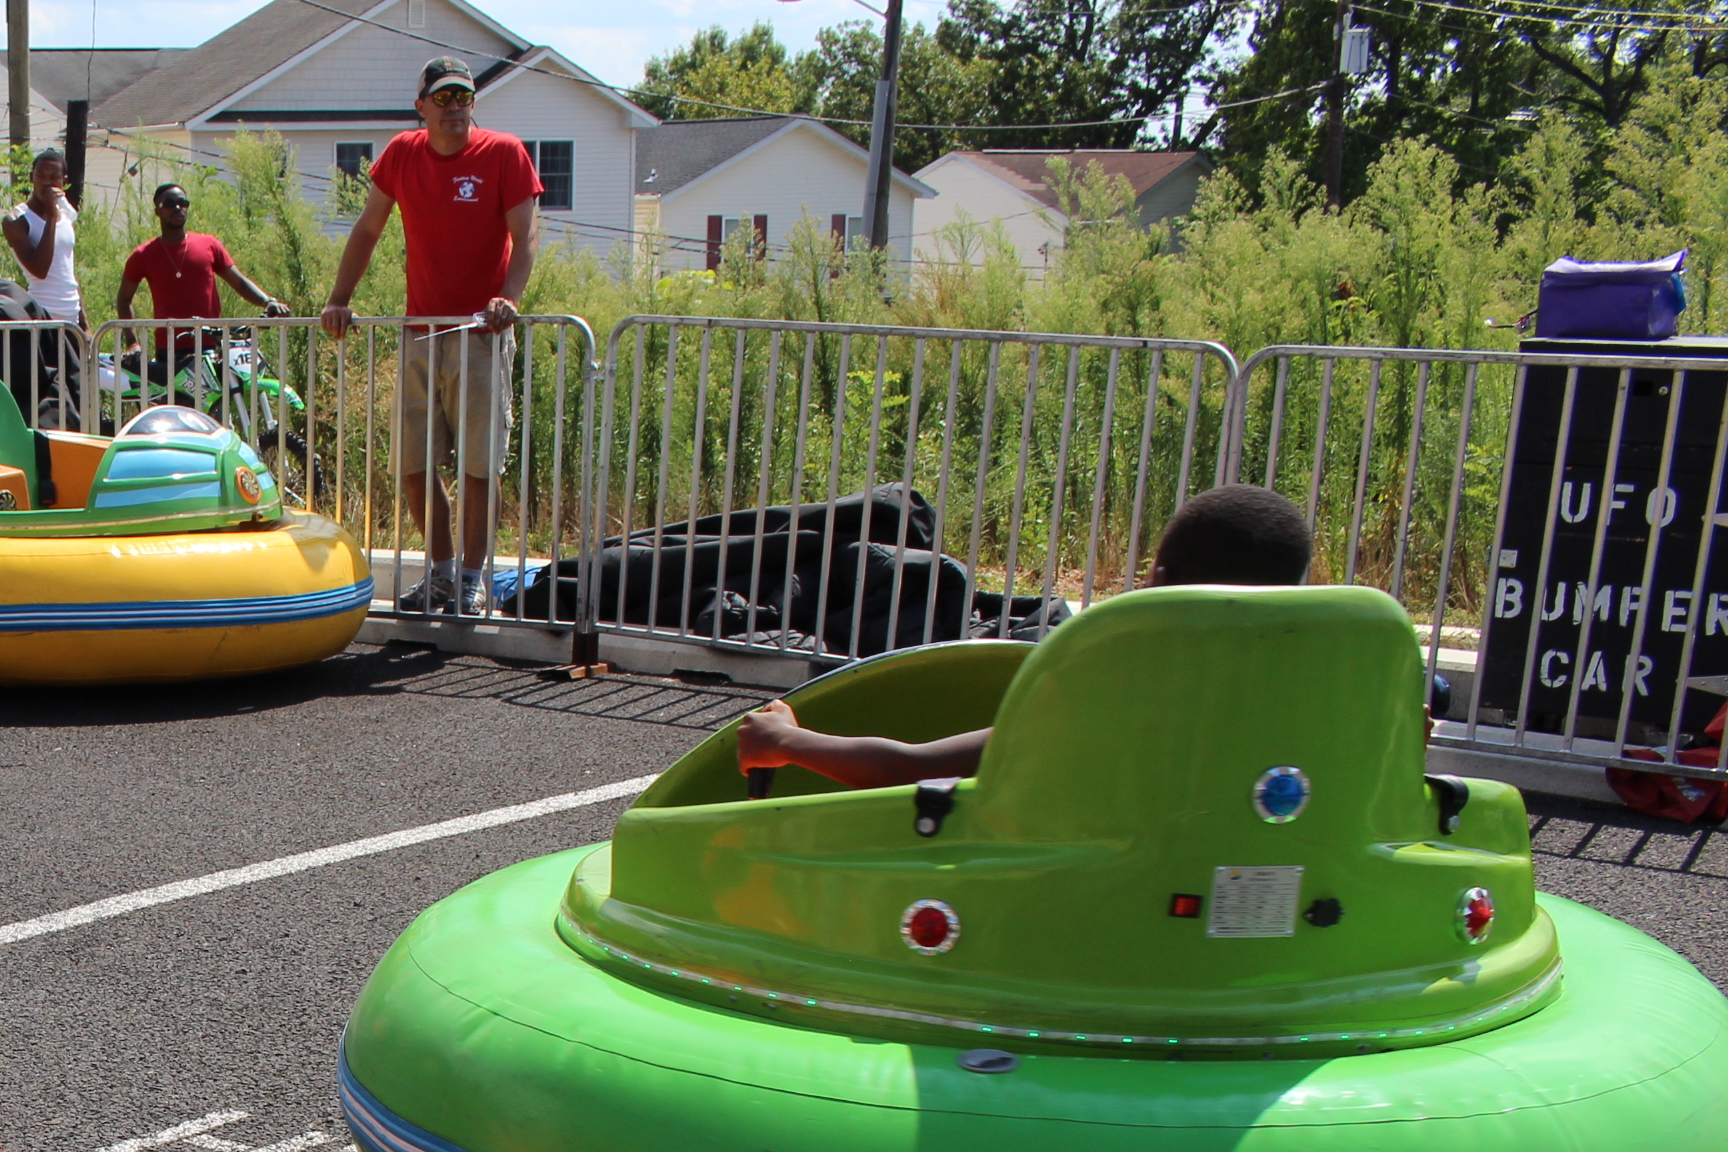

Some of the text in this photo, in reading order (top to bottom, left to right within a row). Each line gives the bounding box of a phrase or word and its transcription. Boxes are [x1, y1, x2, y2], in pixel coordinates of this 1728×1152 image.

[1560, 481, 1677, 529] UFO
[1494, 577, 1728, 637] BUMPER
[1540, 649, 1654, 696] CAR
